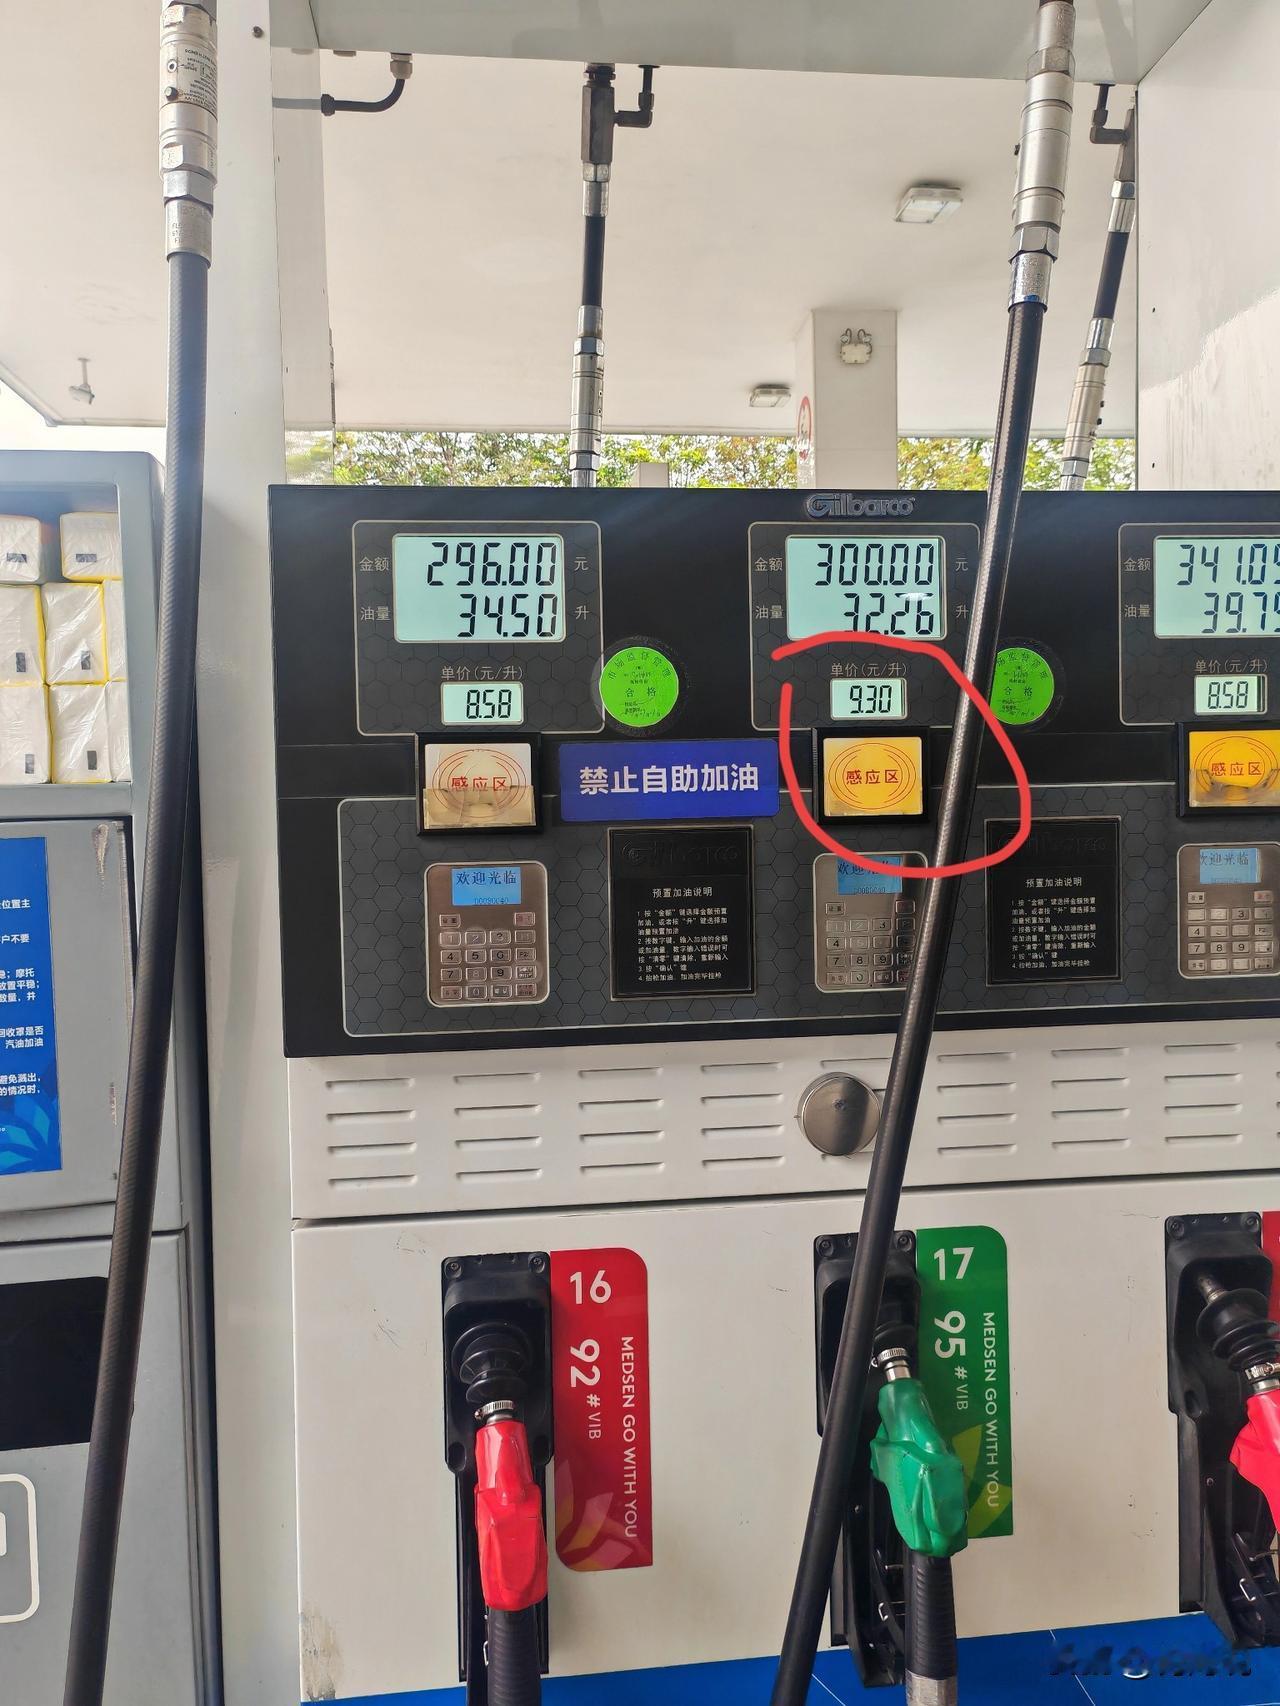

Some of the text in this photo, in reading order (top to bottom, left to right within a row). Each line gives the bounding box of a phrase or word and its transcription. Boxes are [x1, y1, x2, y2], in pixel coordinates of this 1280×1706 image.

[359, 556, 390, 571] 金额
[427, 542, 556, 586] 296.00
[574, 556, 589, 571] 元
[754, 557, 783, 572] 金额
[816, 544, 934, 586] 300.00
[955, 558, 968, 571] 元
[1124, 558, 1150, 572] 金额
[360, 606, 391, 621] 油量
[458, 594, 558, 638] 34.50
[574, 605, 589, 620] 升
[755, 604, 784, 619] 油量
[844, 592, 934, 635] 32.26
[956, 605, 969, 618] 升
[1124, 604, 1150, 618] 油量
[441, 665, 524, 681] 单价(元/升)
[831, 662, 907, 678] 单价(元/升)
[1195, 659, 1268, 674] 单价(元/升)
[850, 686, 892, 714] 9.30
[1208, 681, 1248, 709] 8.58
[466, 690, 512, 719] 8.58
[1211, 762, 1262, 776] 感应区
[452, 776, 508, 792] 感应区
[580, 763, 759, 795] 禁止自助加油
[846, 770, 899, 784] 感应区
[456, 870, 516, 886] 欢迎光临
[1026, 877, 1082, 888] 预置加油说明
[652, 886, 713, 898] 预置加油说明
[0, 899, 30, 910] 位置主
[1238, 910, 1244, 918] 3
[496, 932, 504, 940] 3
[833, 940, 839, 948] 4
[1194, 944, 1200, 952] 7
[1216, 944, 1222, 952] 8
[447, 952, 454, 960] 4
[472, 952, 479, 960] 5
[856, 956, 863, 964] 8
[880, 956, 886, 964] 9
[447, 970, 454, 978] 7
[473, 970, 480, 978] 8
[6, 1038, 44, 1050] 汽油加油
[934, 1246, 975, 1280] 17
[570, 1270, 612, 1304] 16
[957, 1384, 968, 1410] VIB
[983, 1312, 1000, 1508] MEDSEN GO WITH YOU
[588, 1412, 602, 1440] VIB
[622, 1336, 638, 1538] MEDSEN GO WITH YOU
